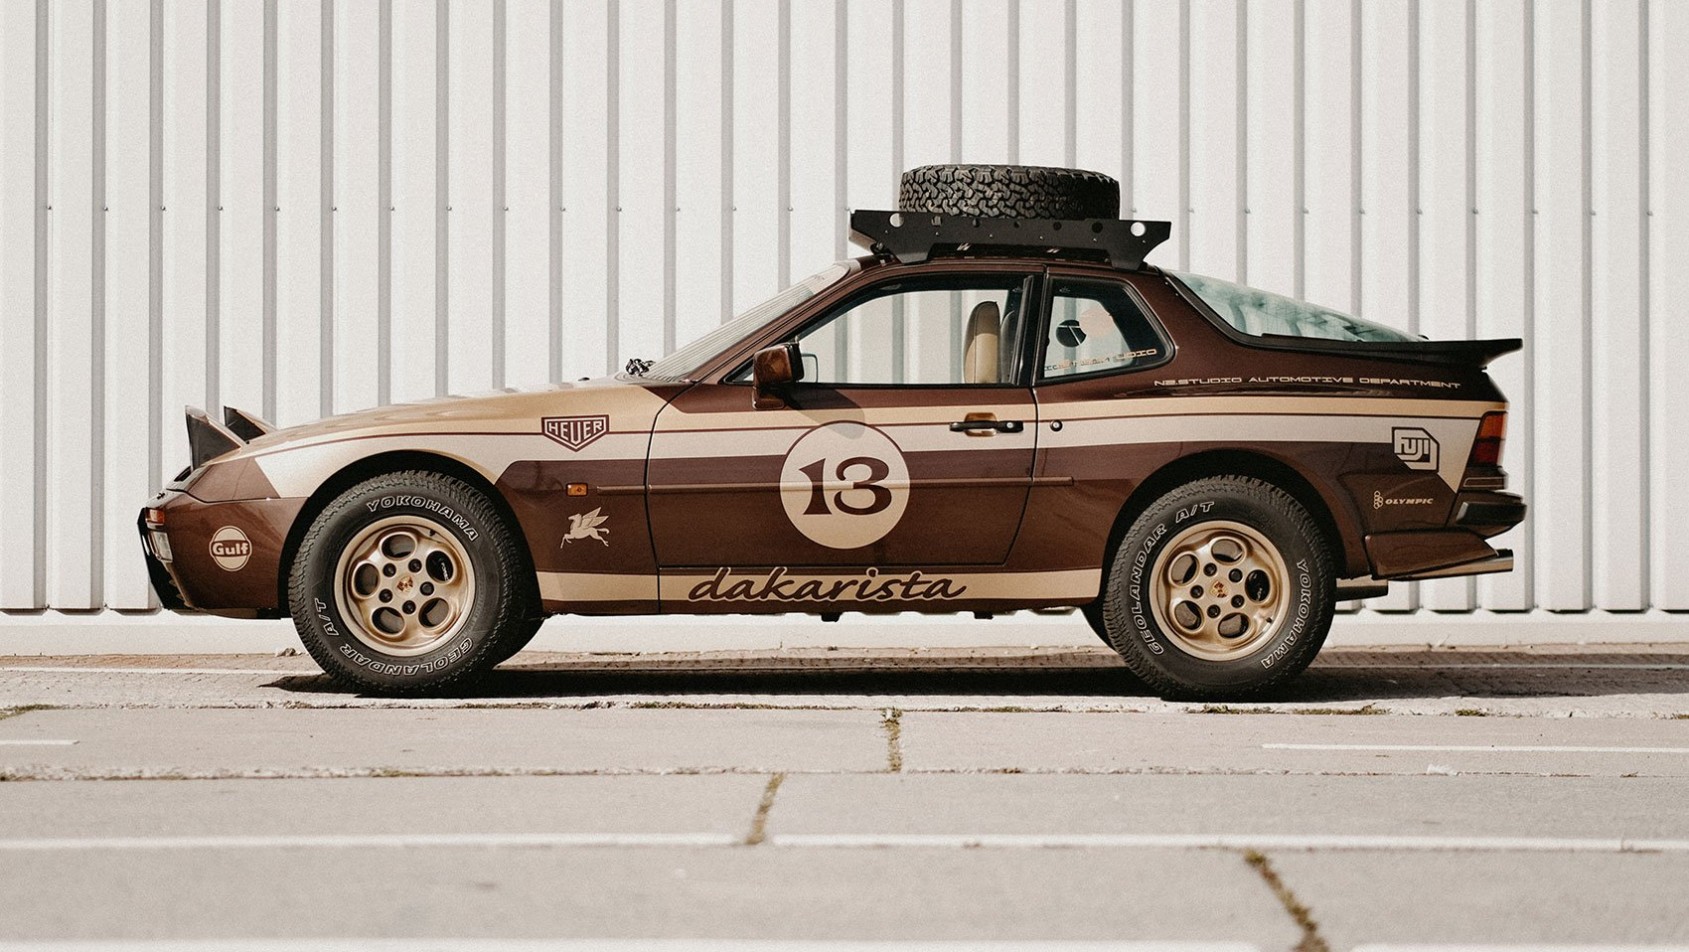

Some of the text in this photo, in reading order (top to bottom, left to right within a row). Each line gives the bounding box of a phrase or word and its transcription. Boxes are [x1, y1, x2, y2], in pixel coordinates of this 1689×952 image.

[1248, 376, 1353, 384] AUTOMOTIVE
[1359, 377, 1461, 389] DEPARTMENT
[548, 420, 603, 445] HEUER
[1392, 427, 1439, 472] FUJI
[798, 456, 892, 516] 13
[366, 495, 479, 541] YOKOHAMA
[212, 542, 249, 556] Gulf
[688, 566, 967, 602] dakarista
[1129, 501, 1215, 656] GEOLANDAR A/T
[1260, 559, 1312, 669] YOKOHAMA
[314, 598, 473, 676] GEOLANDAR A/T
